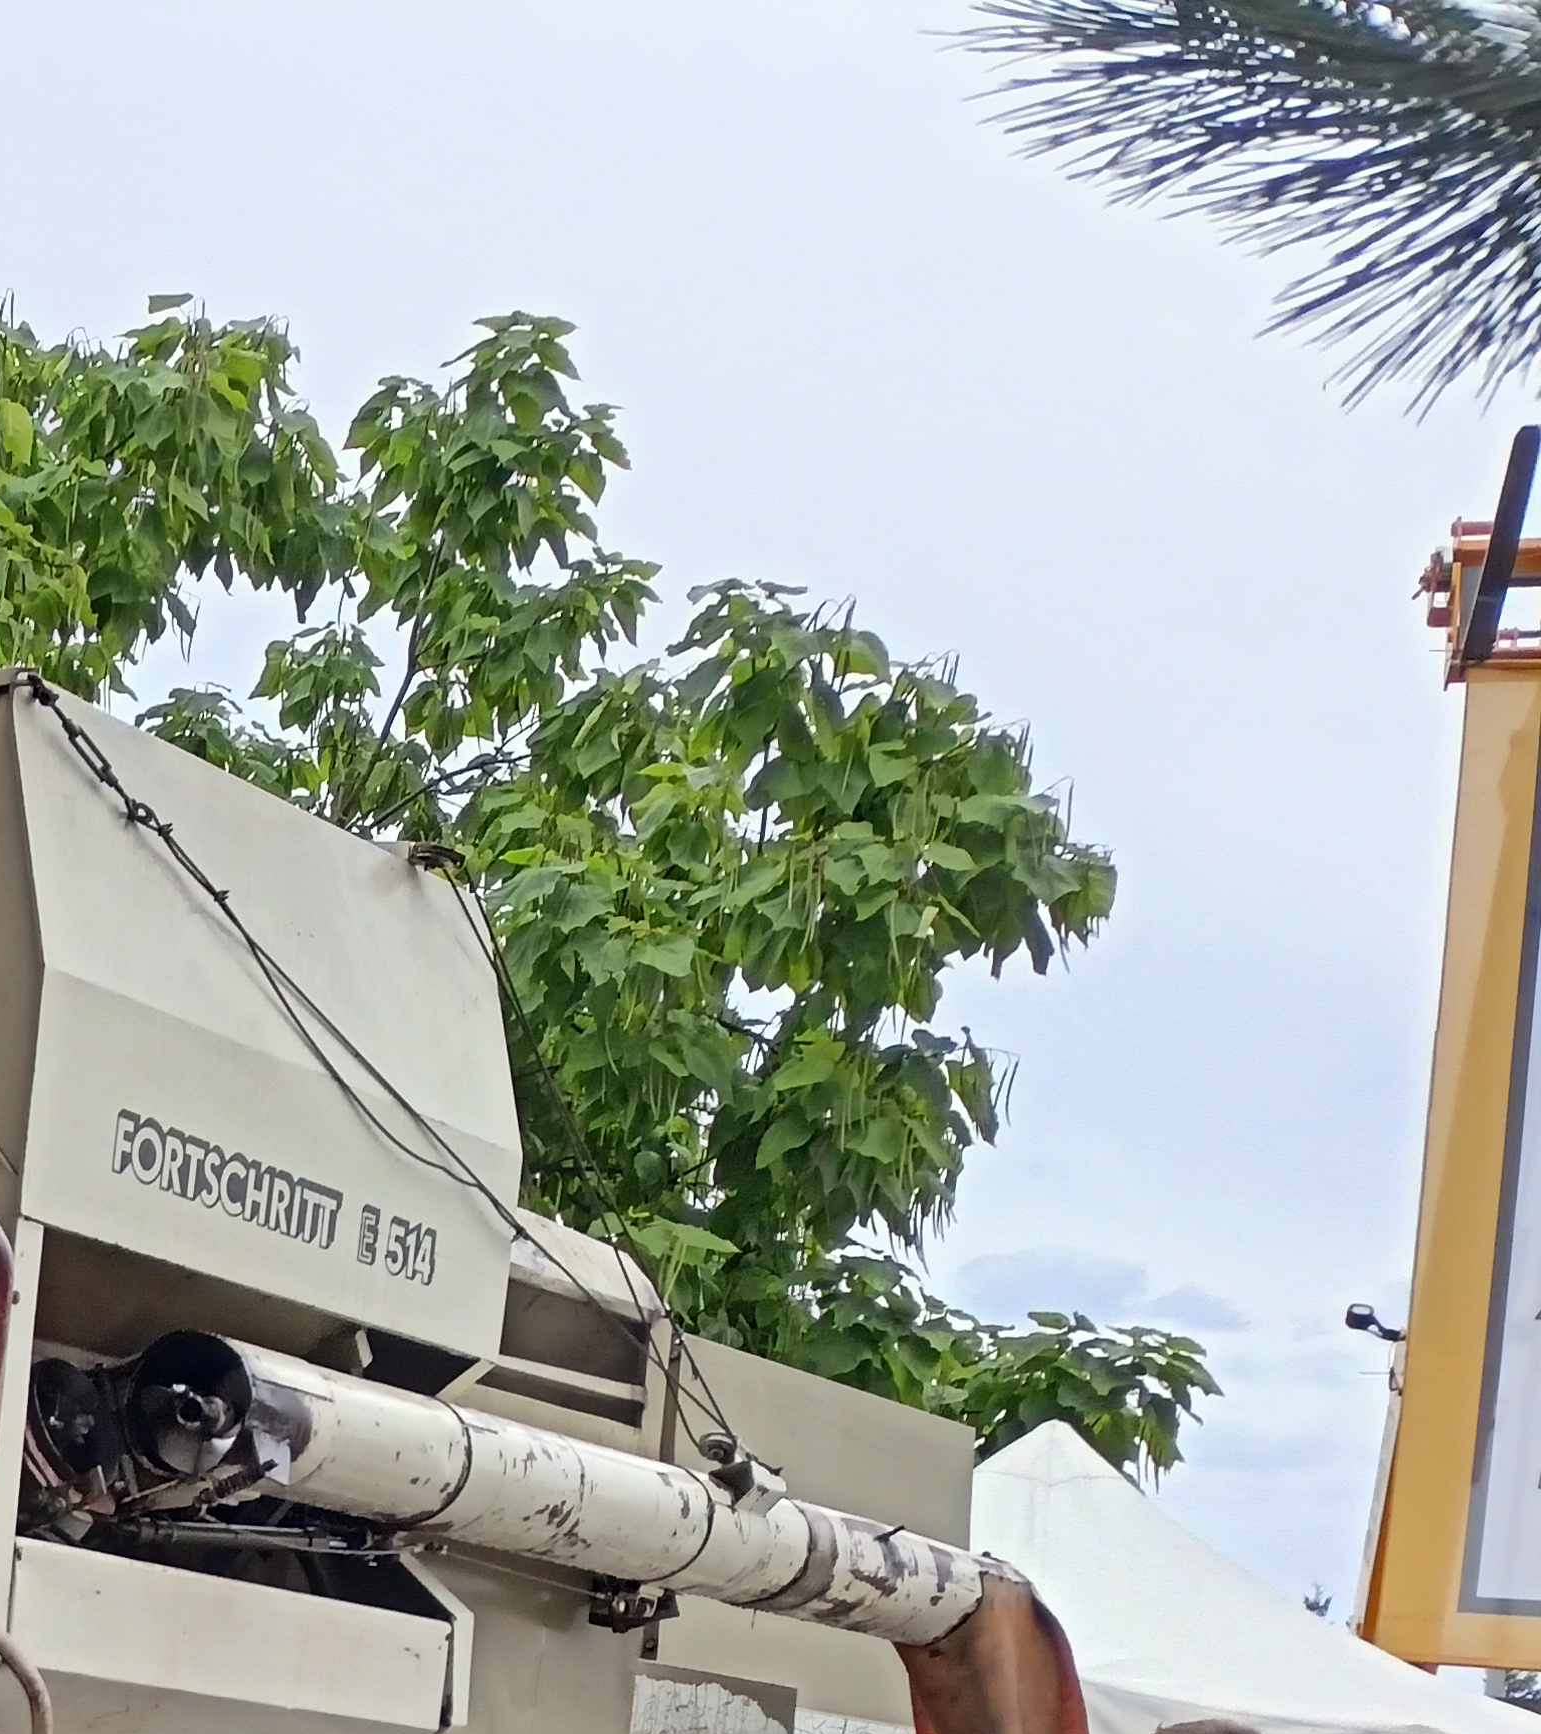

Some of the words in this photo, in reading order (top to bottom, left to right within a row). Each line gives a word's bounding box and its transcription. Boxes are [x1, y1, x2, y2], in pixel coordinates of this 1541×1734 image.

[112, 1108, 343, 1250] FORTSCHRITT
[357, 1203, 381, 1266] E
[384, 1215, 437, 1286] 514
